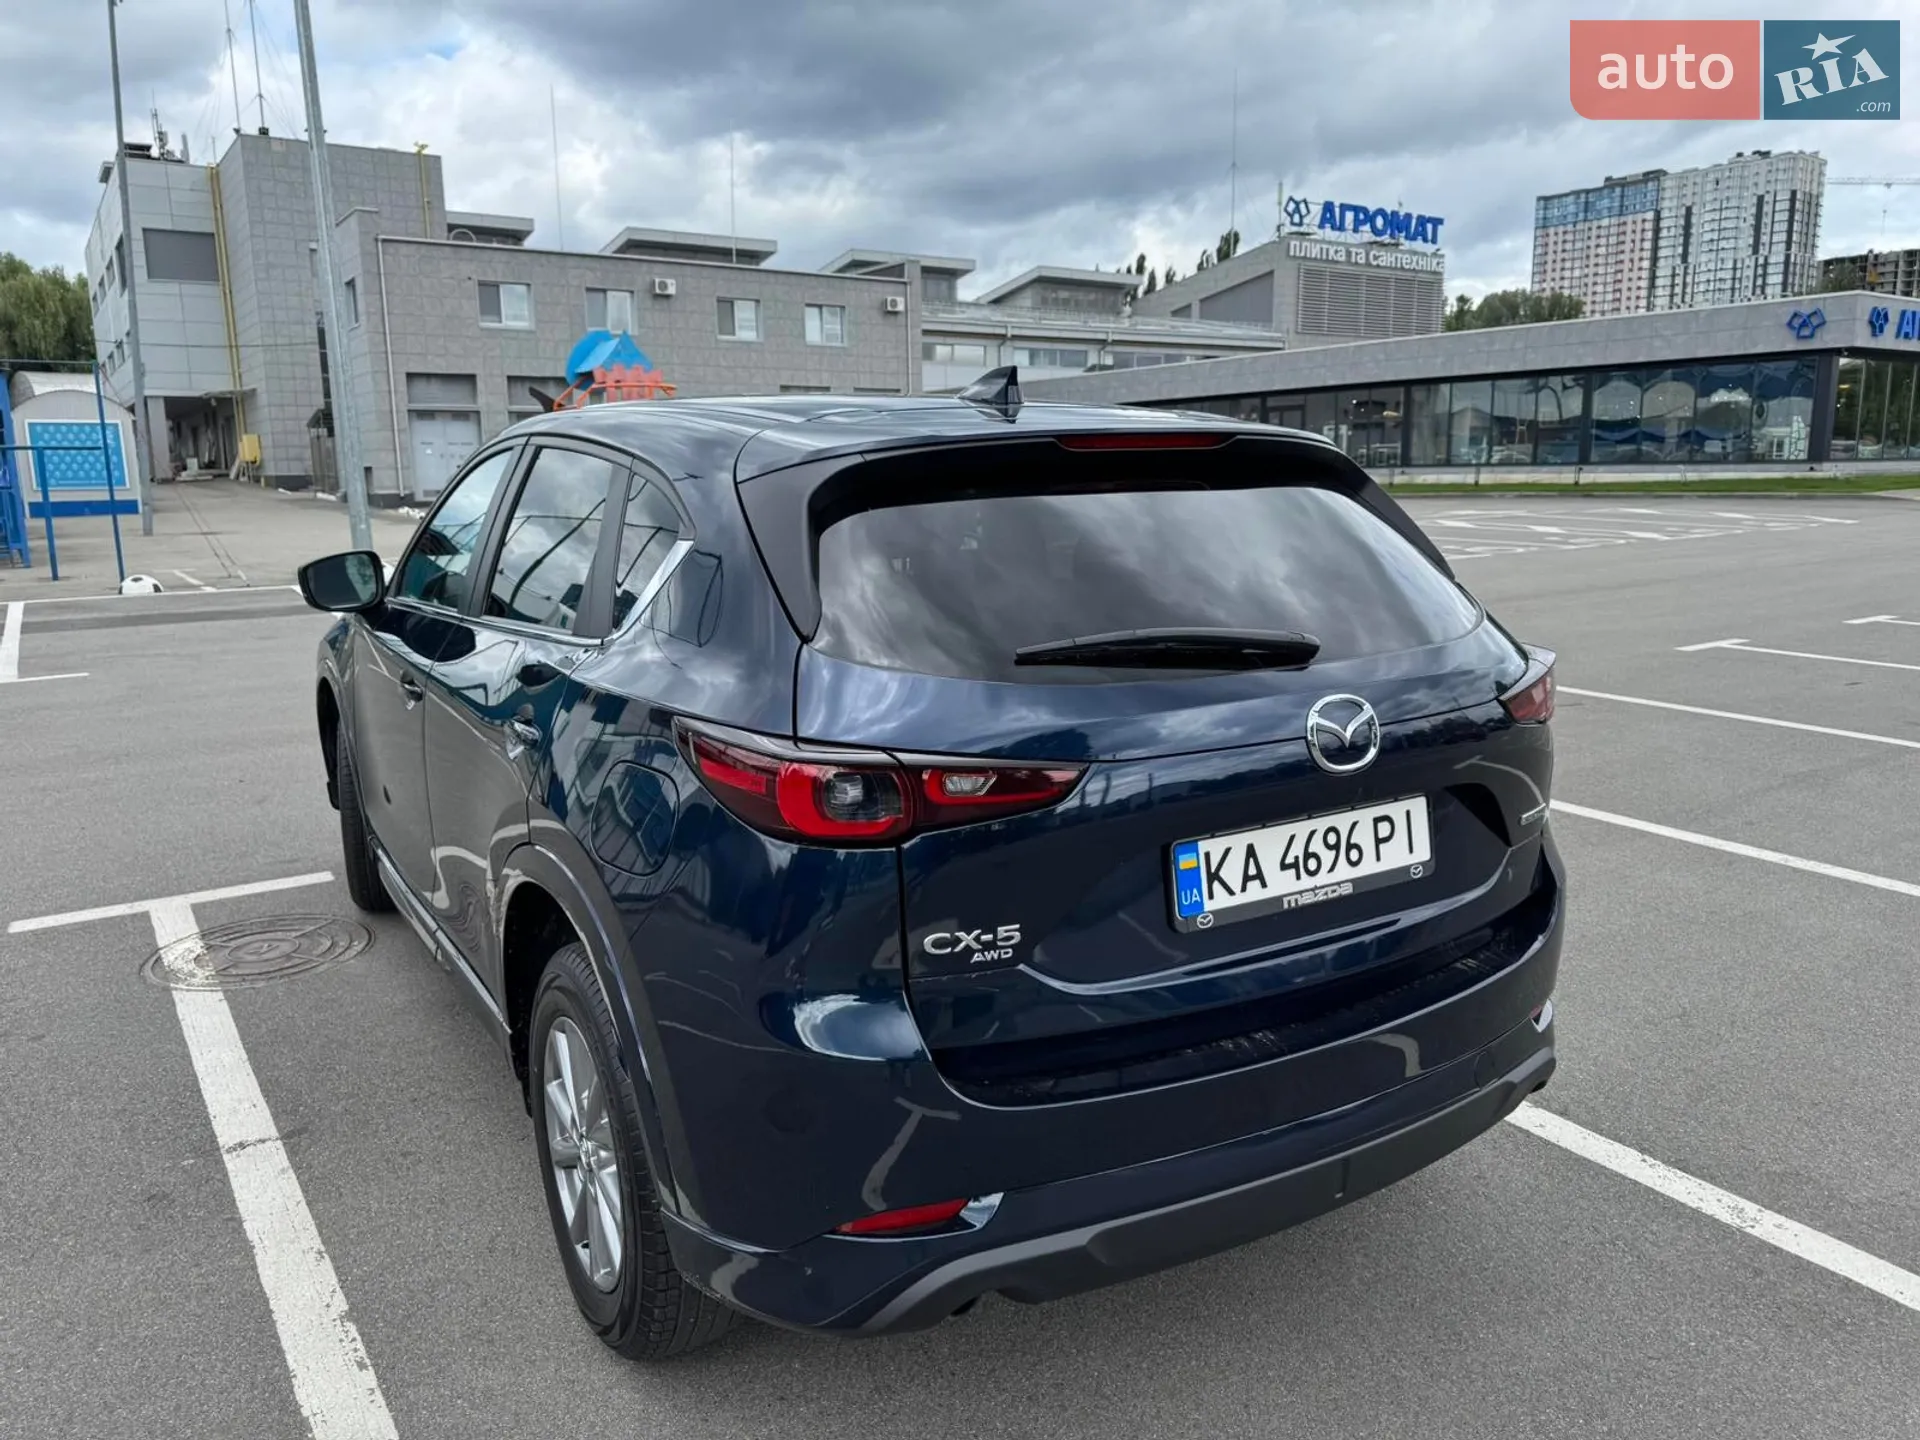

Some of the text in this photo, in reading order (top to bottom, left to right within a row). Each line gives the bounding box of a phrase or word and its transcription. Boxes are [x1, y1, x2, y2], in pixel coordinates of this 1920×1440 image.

[1318, 200, 1446, 245] АГРОМАТ
[1288, 240, 1346, 262] плитка
[1349, 247, 1366, 264] та
[1895, 308, 1920, 341] А
[1279, 820, 1364, 882] 4696
[1181, 889, 1202, 906] UA
[923, 923, 1022, 955] CX-5
[969, 948, 1013, 964] AWD
